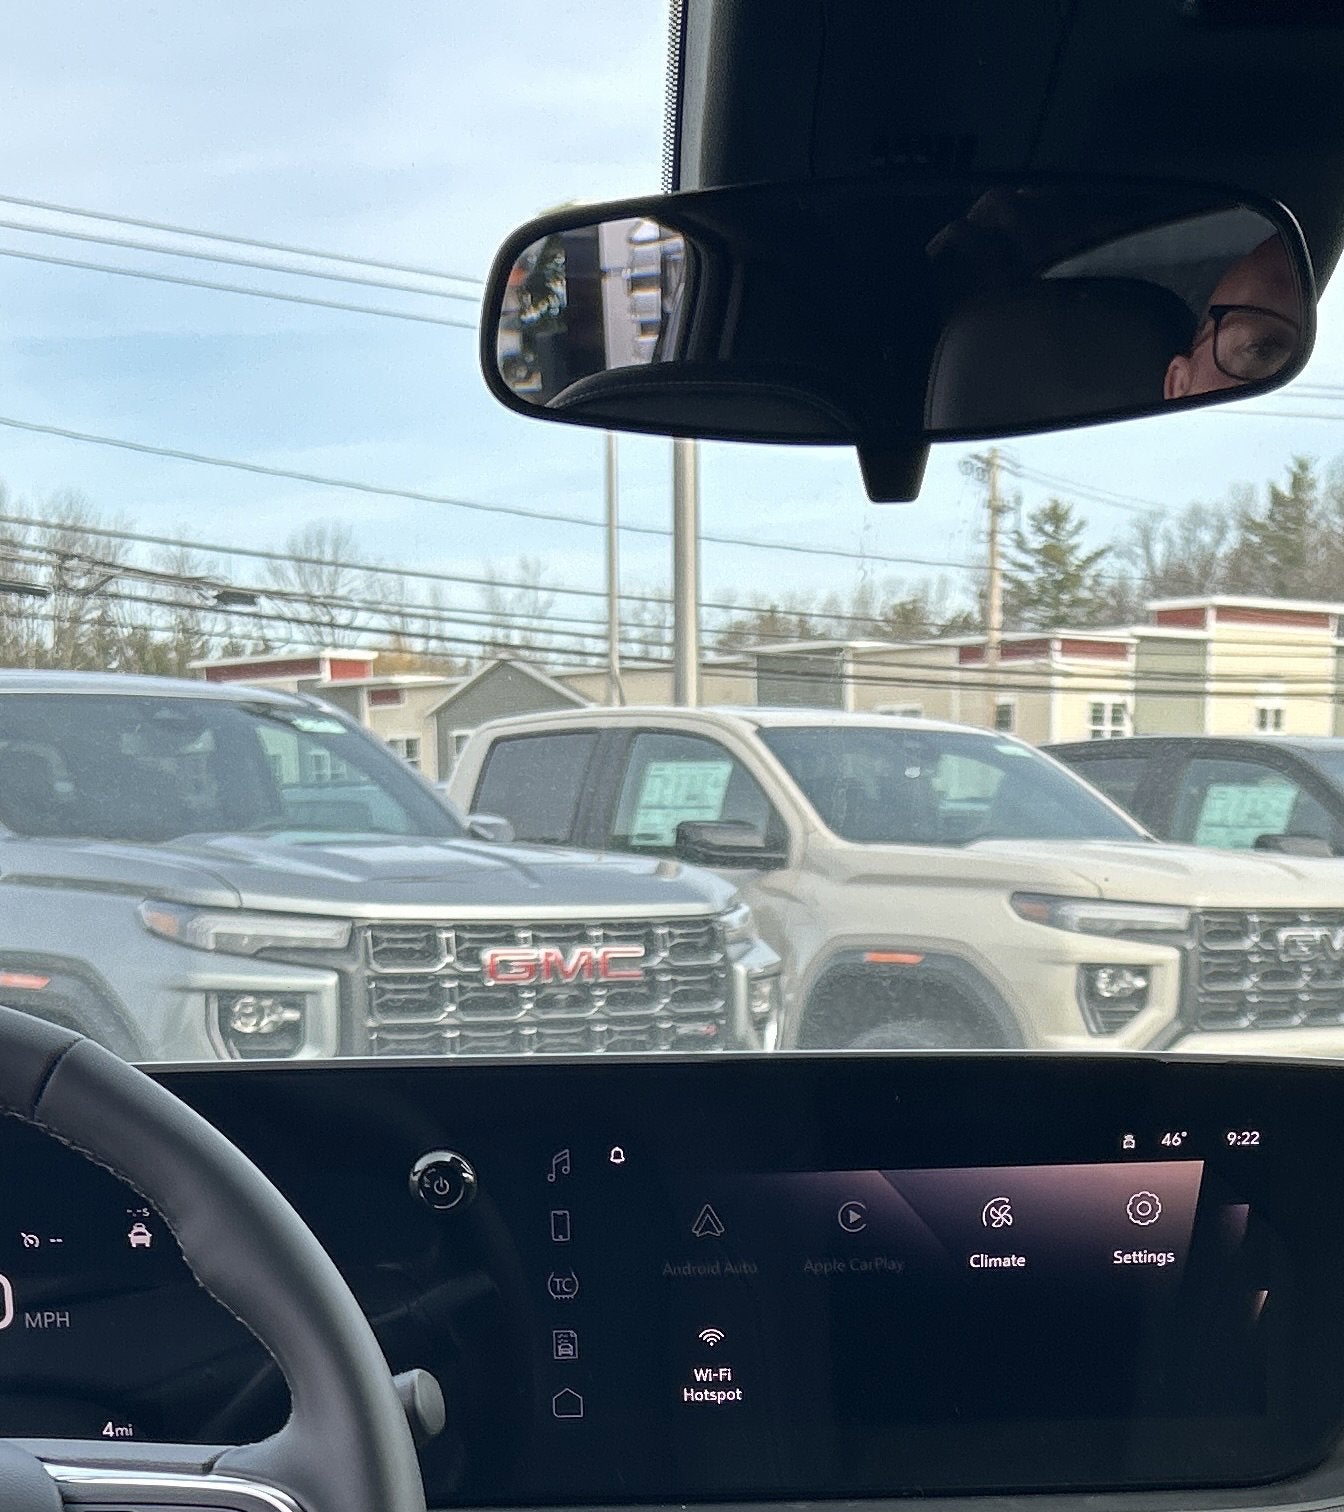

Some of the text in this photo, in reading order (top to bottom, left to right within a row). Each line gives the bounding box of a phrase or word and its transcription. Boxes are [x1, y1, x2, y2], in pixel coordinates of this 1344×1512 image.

[483, 944, 646, 985] GMC
[1226, 1131, 1260, 1146] 9:22
[662, 1258, 758, 1276] Android Auto
[803, 1255, 905, 1275] Apple CarPlay
[969, 1253, 1026, 1268] Climate
[1113, 1250, 1176, 1267] Settings
[553, 1278, 573, 1293] TC
[25, 1311, 71, 1329] MPH
[693, 1367, 733, 1383] Wi-Fi
[683, 1387, 744, 1404] Hotspot
